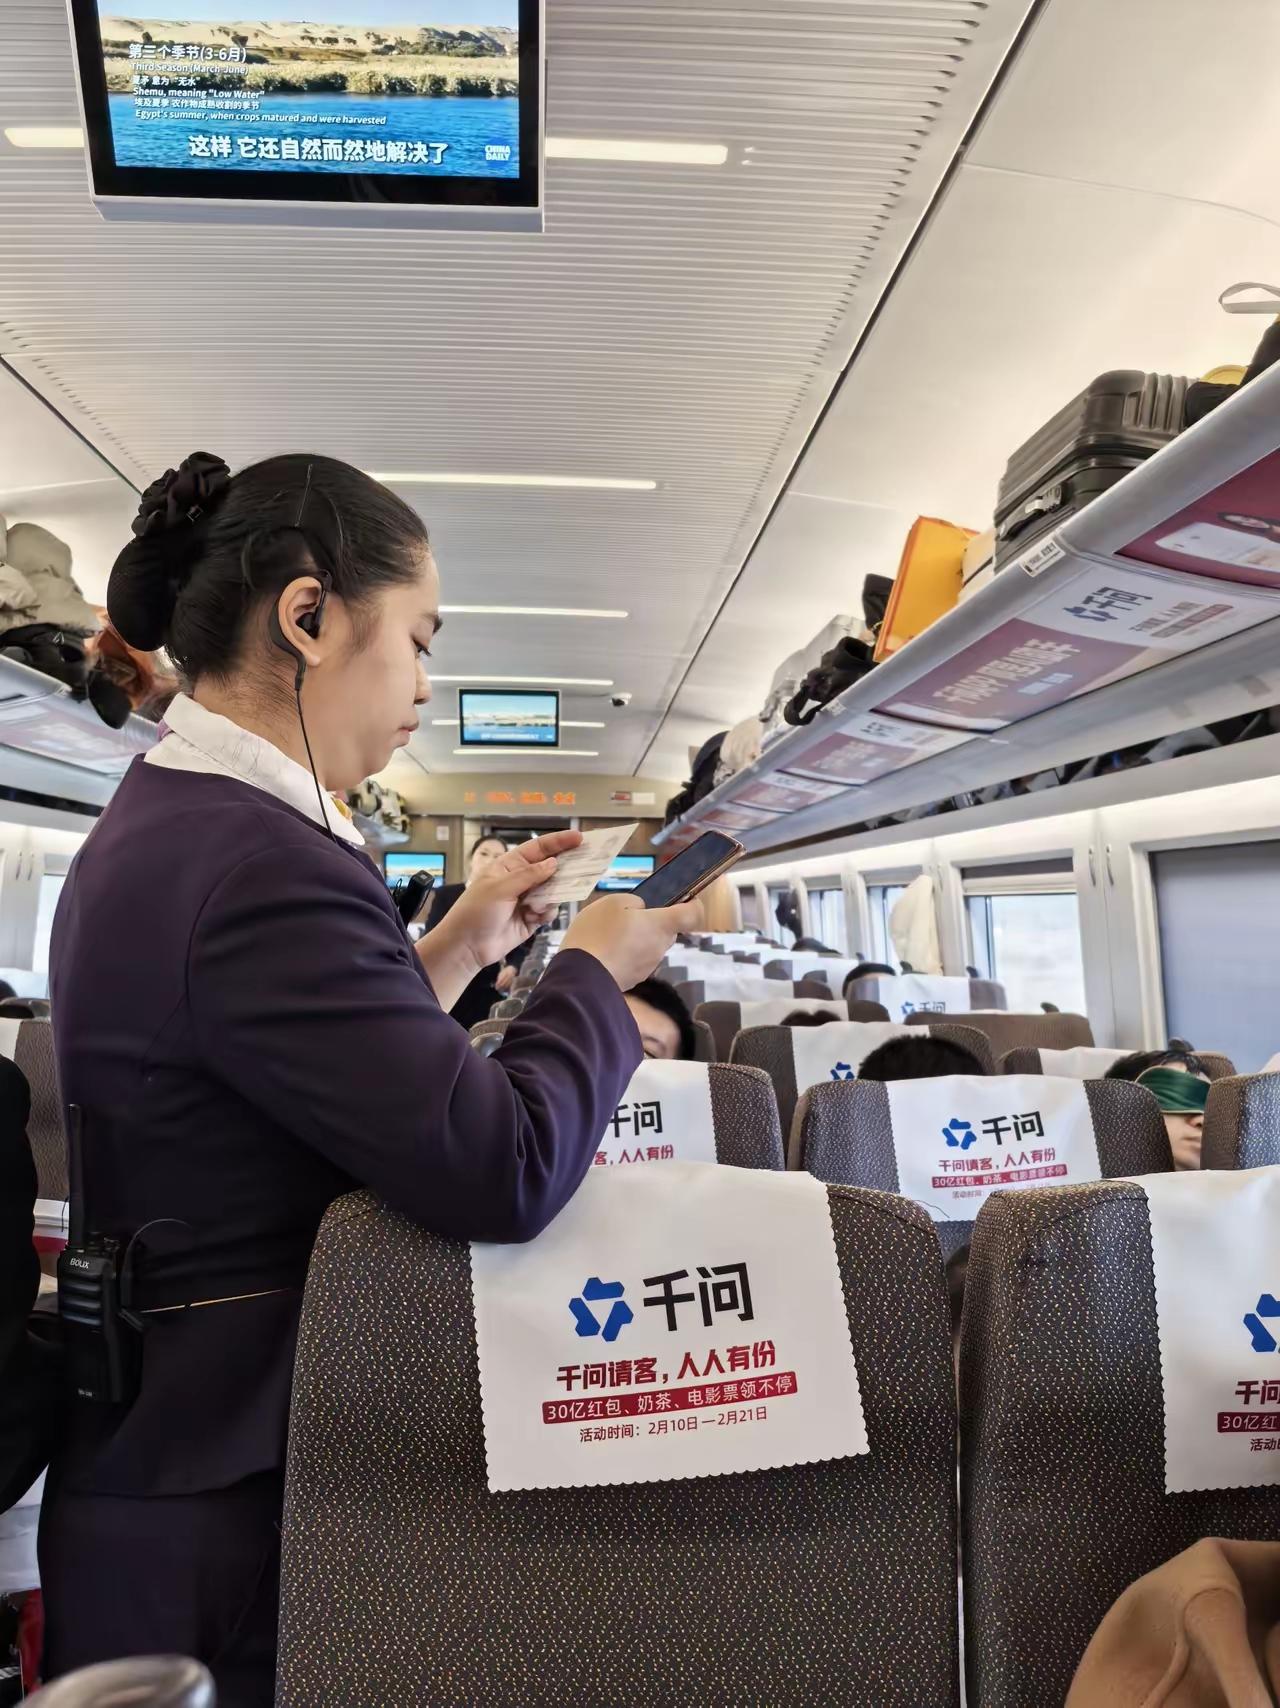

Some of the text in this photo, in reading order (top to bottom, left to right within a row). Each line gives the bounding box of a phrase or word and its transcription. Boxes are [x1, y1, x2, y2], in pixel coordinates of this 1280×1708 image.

[128, 44, 247, 62] 第三个季节(3-6月)
[131, 63, 154, 72] Third
[156, 64, 187, 73] Season
[133, 87, 166, 97] Shemu,
[168, 88, 206, 99] meaning
[134, 98, 170, 108] 埃及夏季
[136, 110, 167, 121] Egypt's
[169, 112, 208, 121] summer,
[210, 112, 234, 121] when
[236, 113, 260, 122] crops
[262, 113, 299, 122] matured
[301, 114, 318, 122] and
[343, 116, 386, 125] harvested
[188, 135, 448, 164] 这样 它还自然而然地解决了
[486, 152, 510, 161] DAILY
[610, 1101, 663, 1138] 千问
[981, 1111, 1045, 1145] 千问
[643, 1262, 754, 1332] 千问
[557, 1339, 776, 1391] 千问请客，人人有份
[548, 1374, 792, 1420] 30亿红包、奶茶、电影票领不停
[1235, 1380, 1280, 1405] 千问
